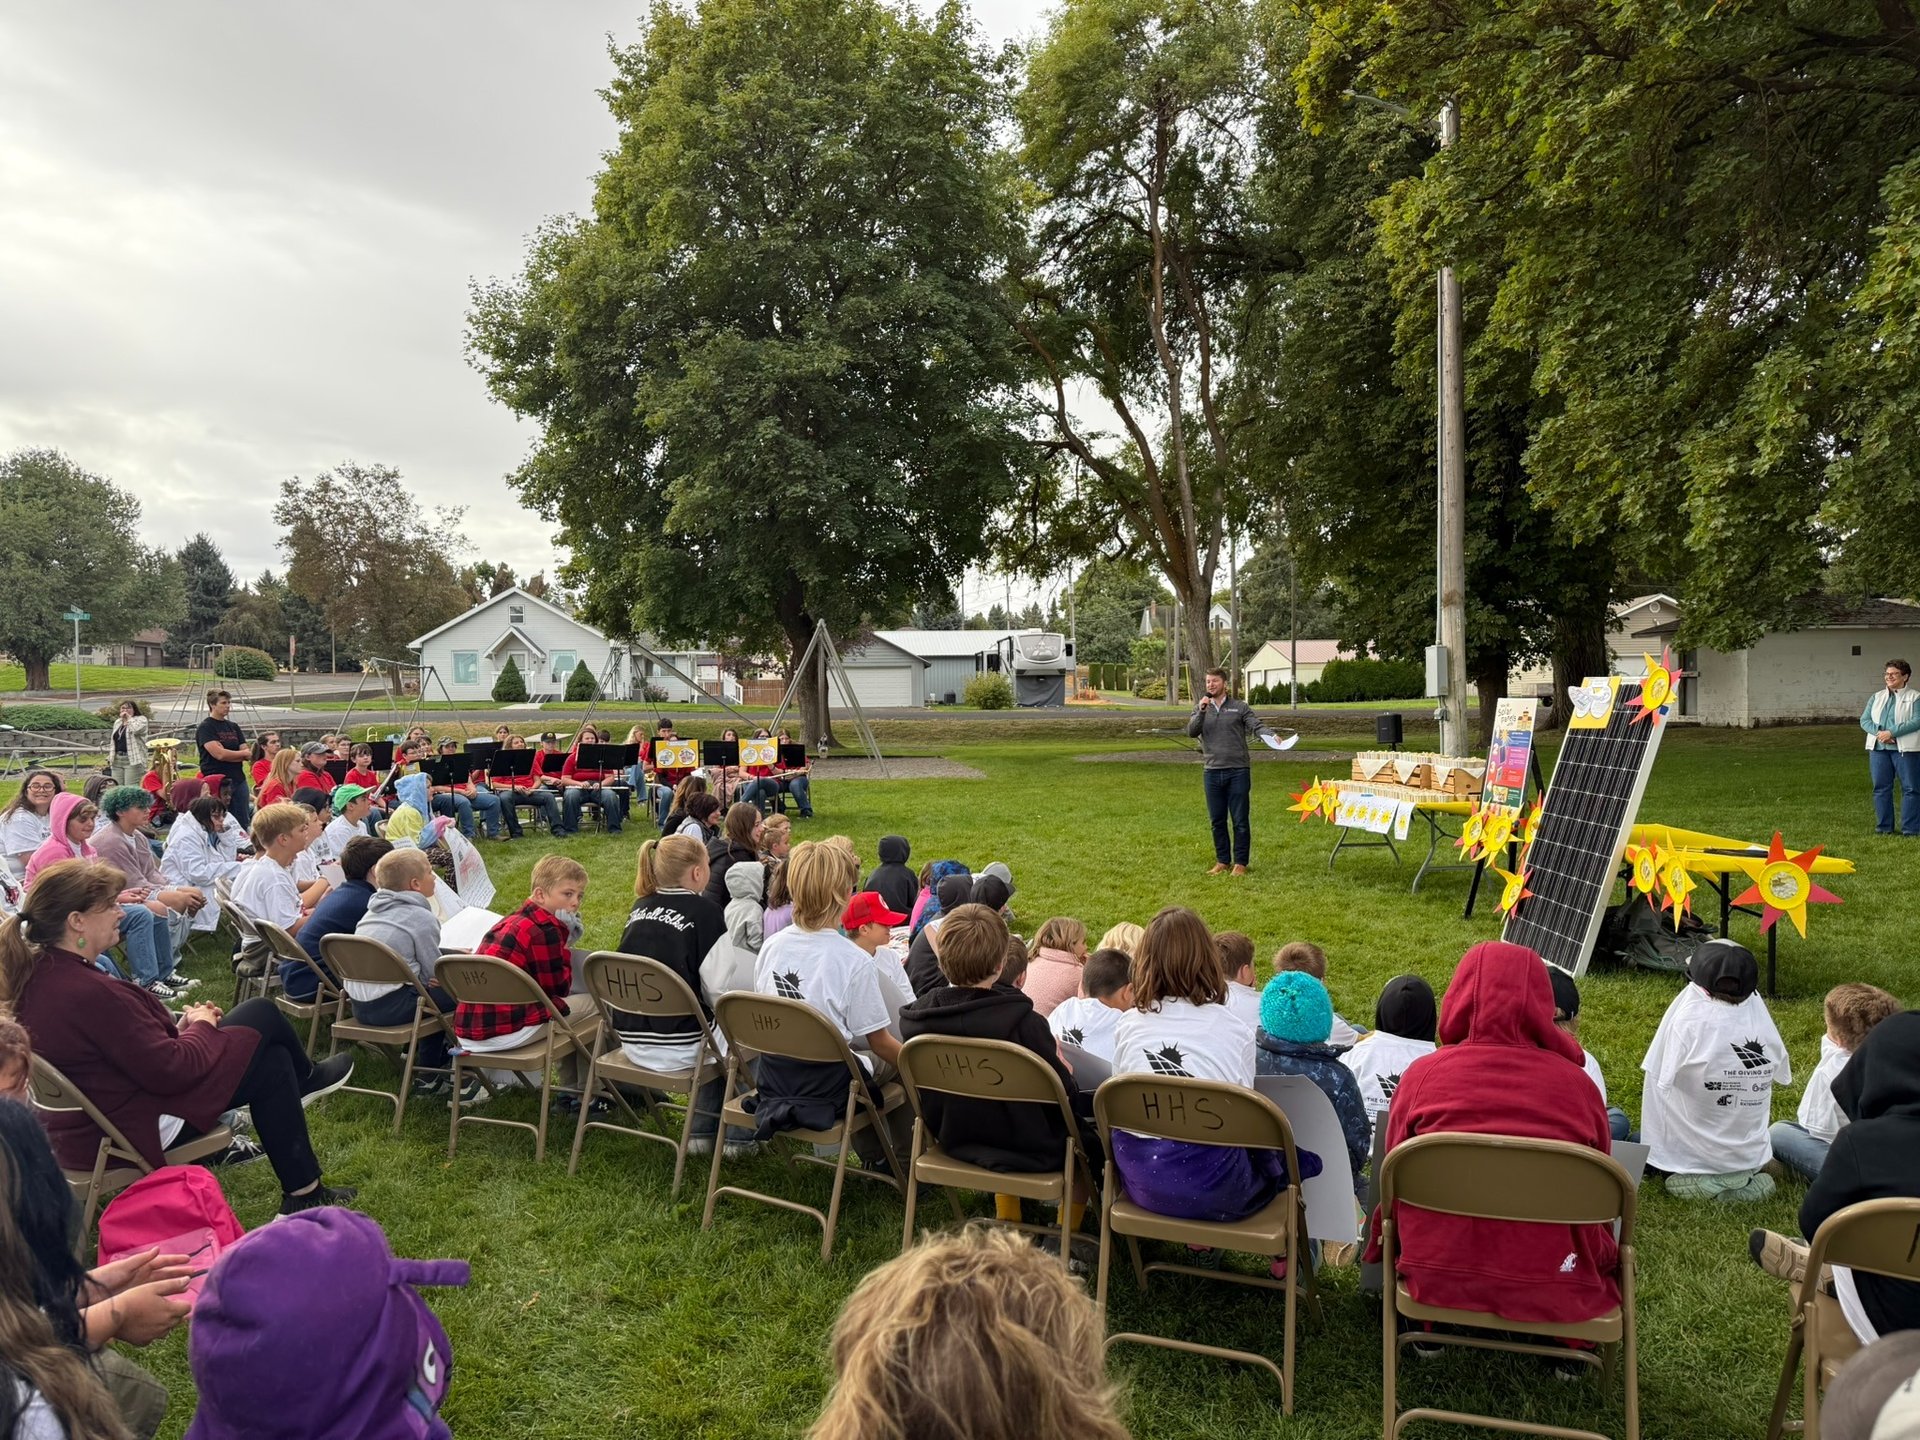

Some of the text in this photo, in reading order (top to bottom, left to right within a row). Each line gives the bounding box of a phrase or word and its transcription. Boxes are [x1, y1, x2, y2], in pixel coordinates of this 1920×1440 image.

[1492, 743, 1499, 754] 2
[1490, 761, 1496, 772] 3
[646, 906, 664, 920] all
[461, 971, 488, 986] HHS
[604, 965, 663, 1002] HHS
[751, 1011, 781, 1031] HHS
[935, 1054, 1004, 1086] HHS
[1142, 1091, 1224, 1130] HHS
